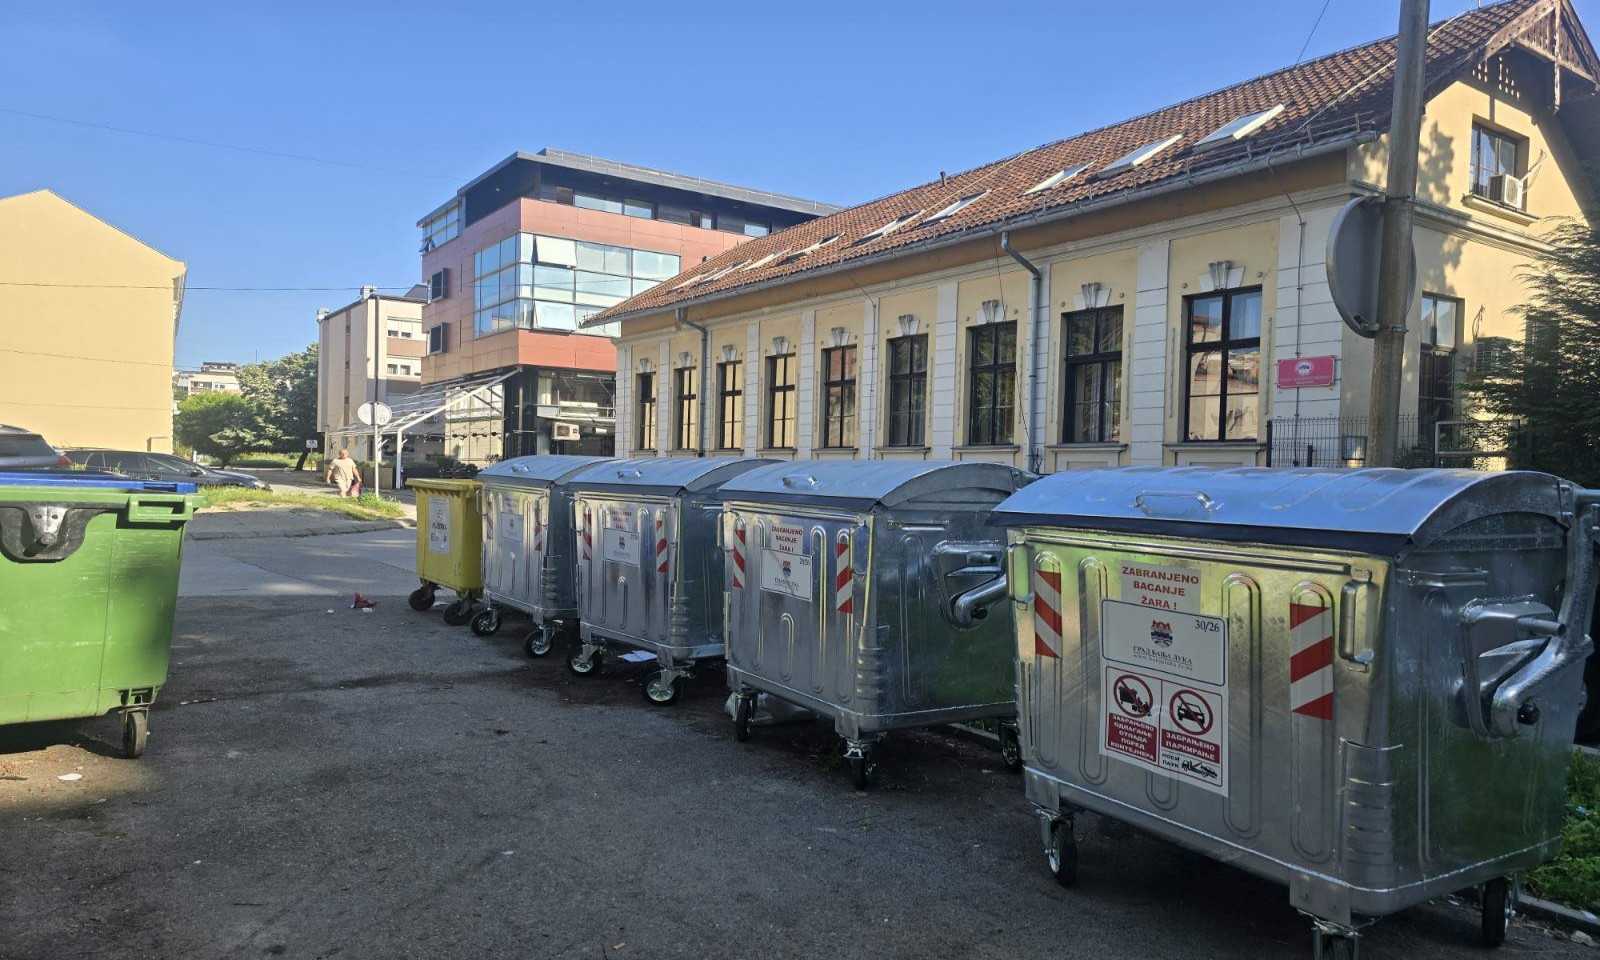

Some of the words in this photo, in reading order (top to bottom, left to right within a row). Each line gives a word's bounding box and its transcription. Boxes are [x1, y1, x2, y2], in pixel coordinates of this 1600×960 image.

[1122, 566, 1200, 585] ZABRANJENO
[1133, 581, 1185, 597] BACANJE
[1141, 595, 1170, 610] ŽARA
[1194, 619, 1220, 633] 30/26
[1112, 714, 1155, 732] ЗАБРАЊЕНО
[1113, 722, 1153, 738] ОДЛАГАЊЕ
[1118, 730, 1148, 743] ОТПАДА
[1121, 738, 1146, 750] ПОРЕД
[1165, 732, 1215, 751] ЗАБРАЊЕНО
[1110, 741, 1154, 760] КОНТЕЈНЕРА
[1161, 753, 1180, 762] НОСИ
[1165, 741, 1215, 760] ПАРКИРАЊЕ
[1162, 760, 1180, 769] ПАУК
